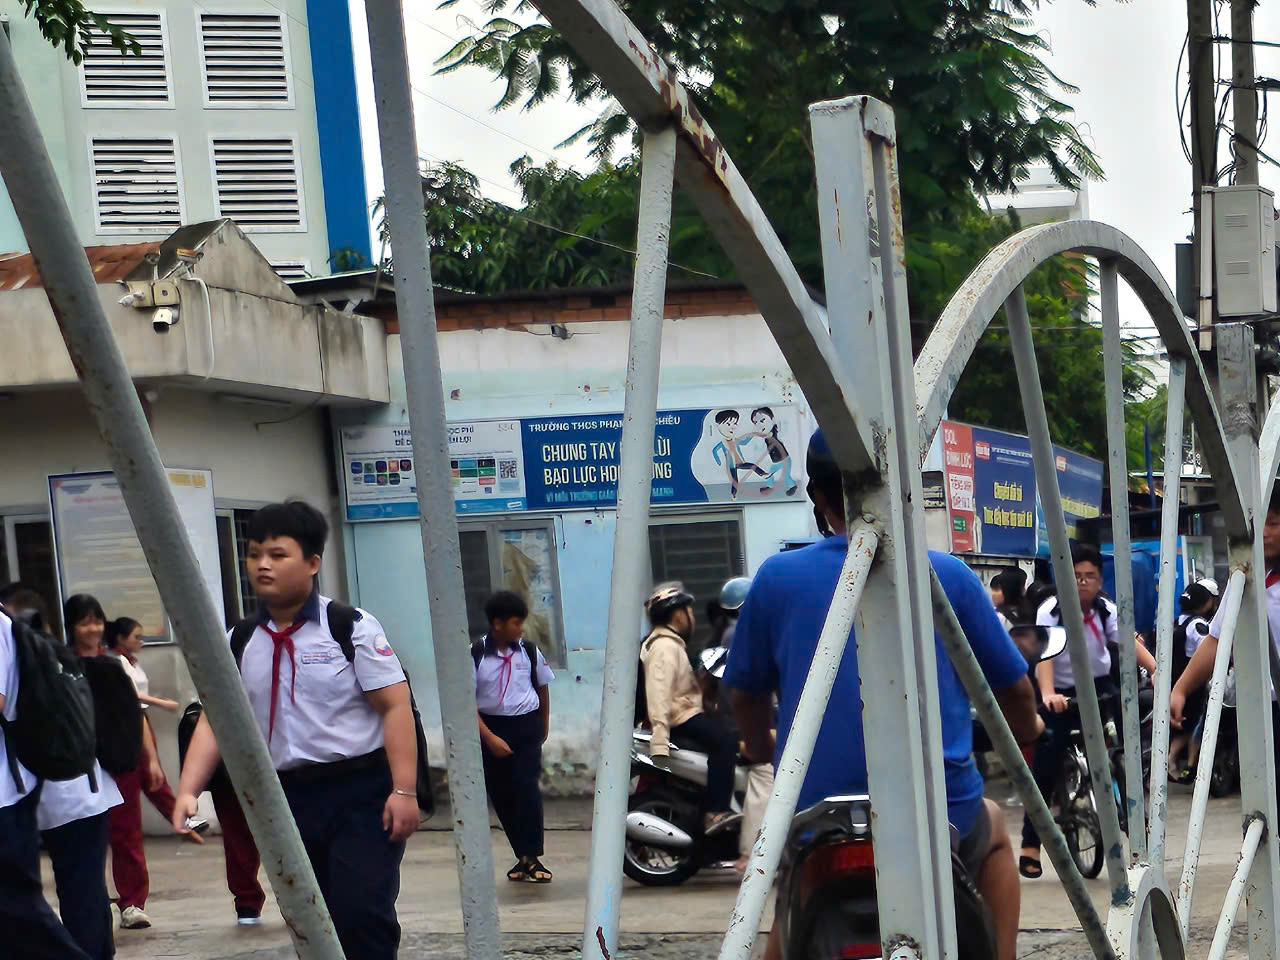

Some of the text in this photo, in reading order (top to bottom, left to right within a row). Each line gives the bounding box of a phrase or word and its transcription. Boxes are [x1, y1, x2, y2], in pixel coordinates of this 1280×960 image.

[542, 443, 587, 462] CHUNG
[590, 442, 616, 460] TAY
[544, 468, 570, 488] BẠO
[573, 465, 597, 487] LỰC
